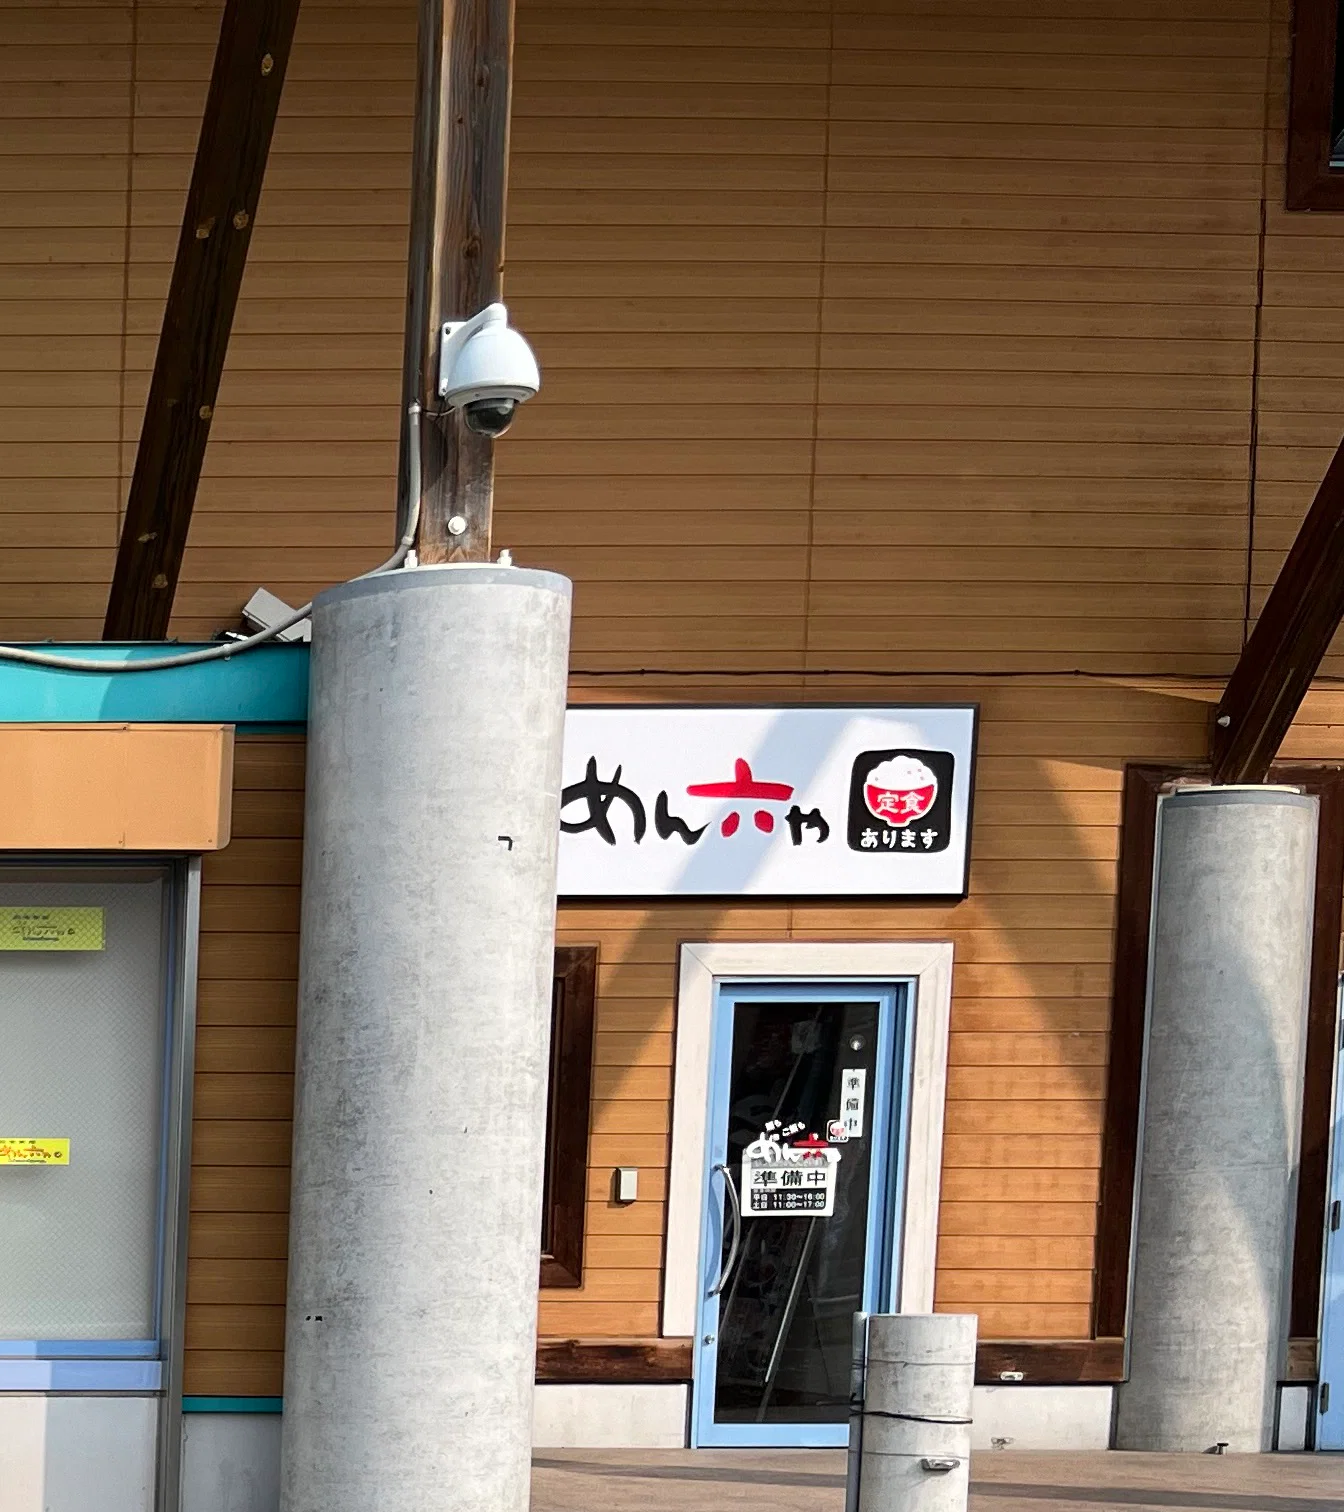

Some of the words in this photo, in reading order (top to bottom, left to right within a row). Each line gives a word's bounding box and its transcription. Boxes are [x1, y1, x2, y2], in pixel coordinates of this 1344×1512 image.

[560, 755, 830, 846] めん六や
[875, 791, 925, 815] 定食
[860, 827, 939, 849] あります
[753, 1170, 826, 1187] 準備中
